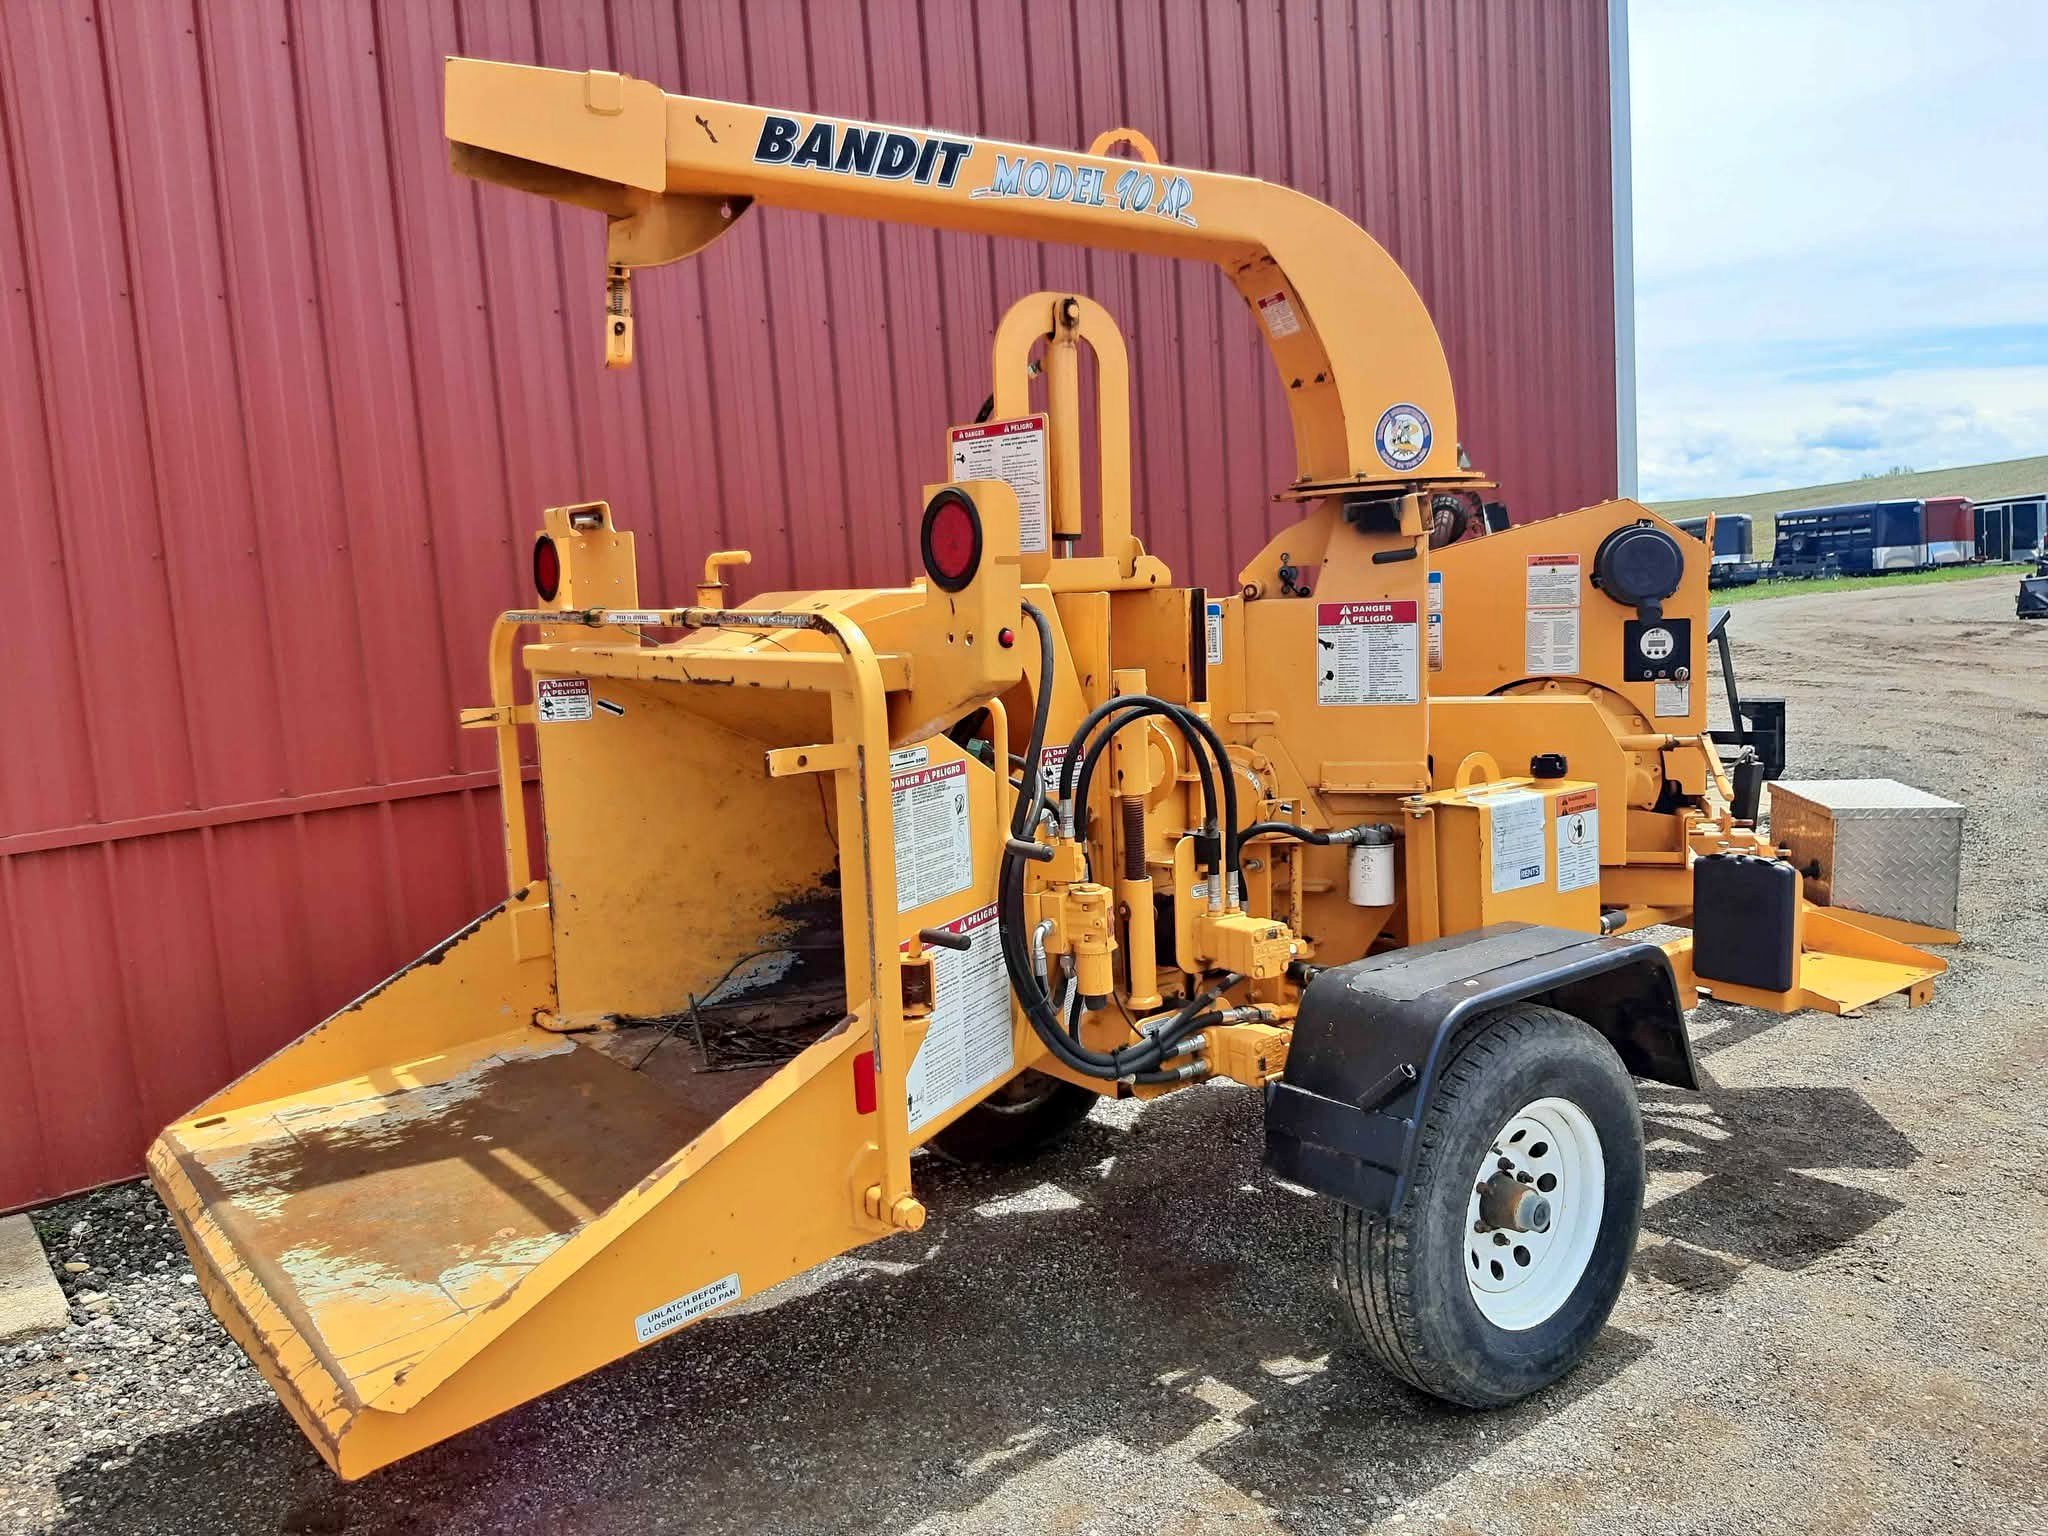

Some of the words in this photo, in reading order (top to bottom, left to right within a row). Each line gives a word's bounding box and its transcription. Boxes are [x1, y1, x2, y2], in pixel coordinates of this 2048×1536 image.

[753, 115, 974, 187] BANDIT
[990, 155, 1106, 206] MODEL
[1115, 168, 1154, 212] 90
[1156, 175, 1193, 218] XP
[1010, 422, 1034, 432] PELIGRO
[1352, 605, 1392, 613] DANGER
[1352, 615, 1393, 623] PELIGRO
[932, 764, 961, 780] PELIGRO
[968, 905, 998, 926] PELIGRO
[647, 1299, 690, 1323] UNLATCH
[691, 1281, 728, 1302] BEFORE
[642, 1313, 683, 1337] CLOSING
[684, 1298, 717, 1317] INFEED
[719, 1288, 736, 1301] PAN
